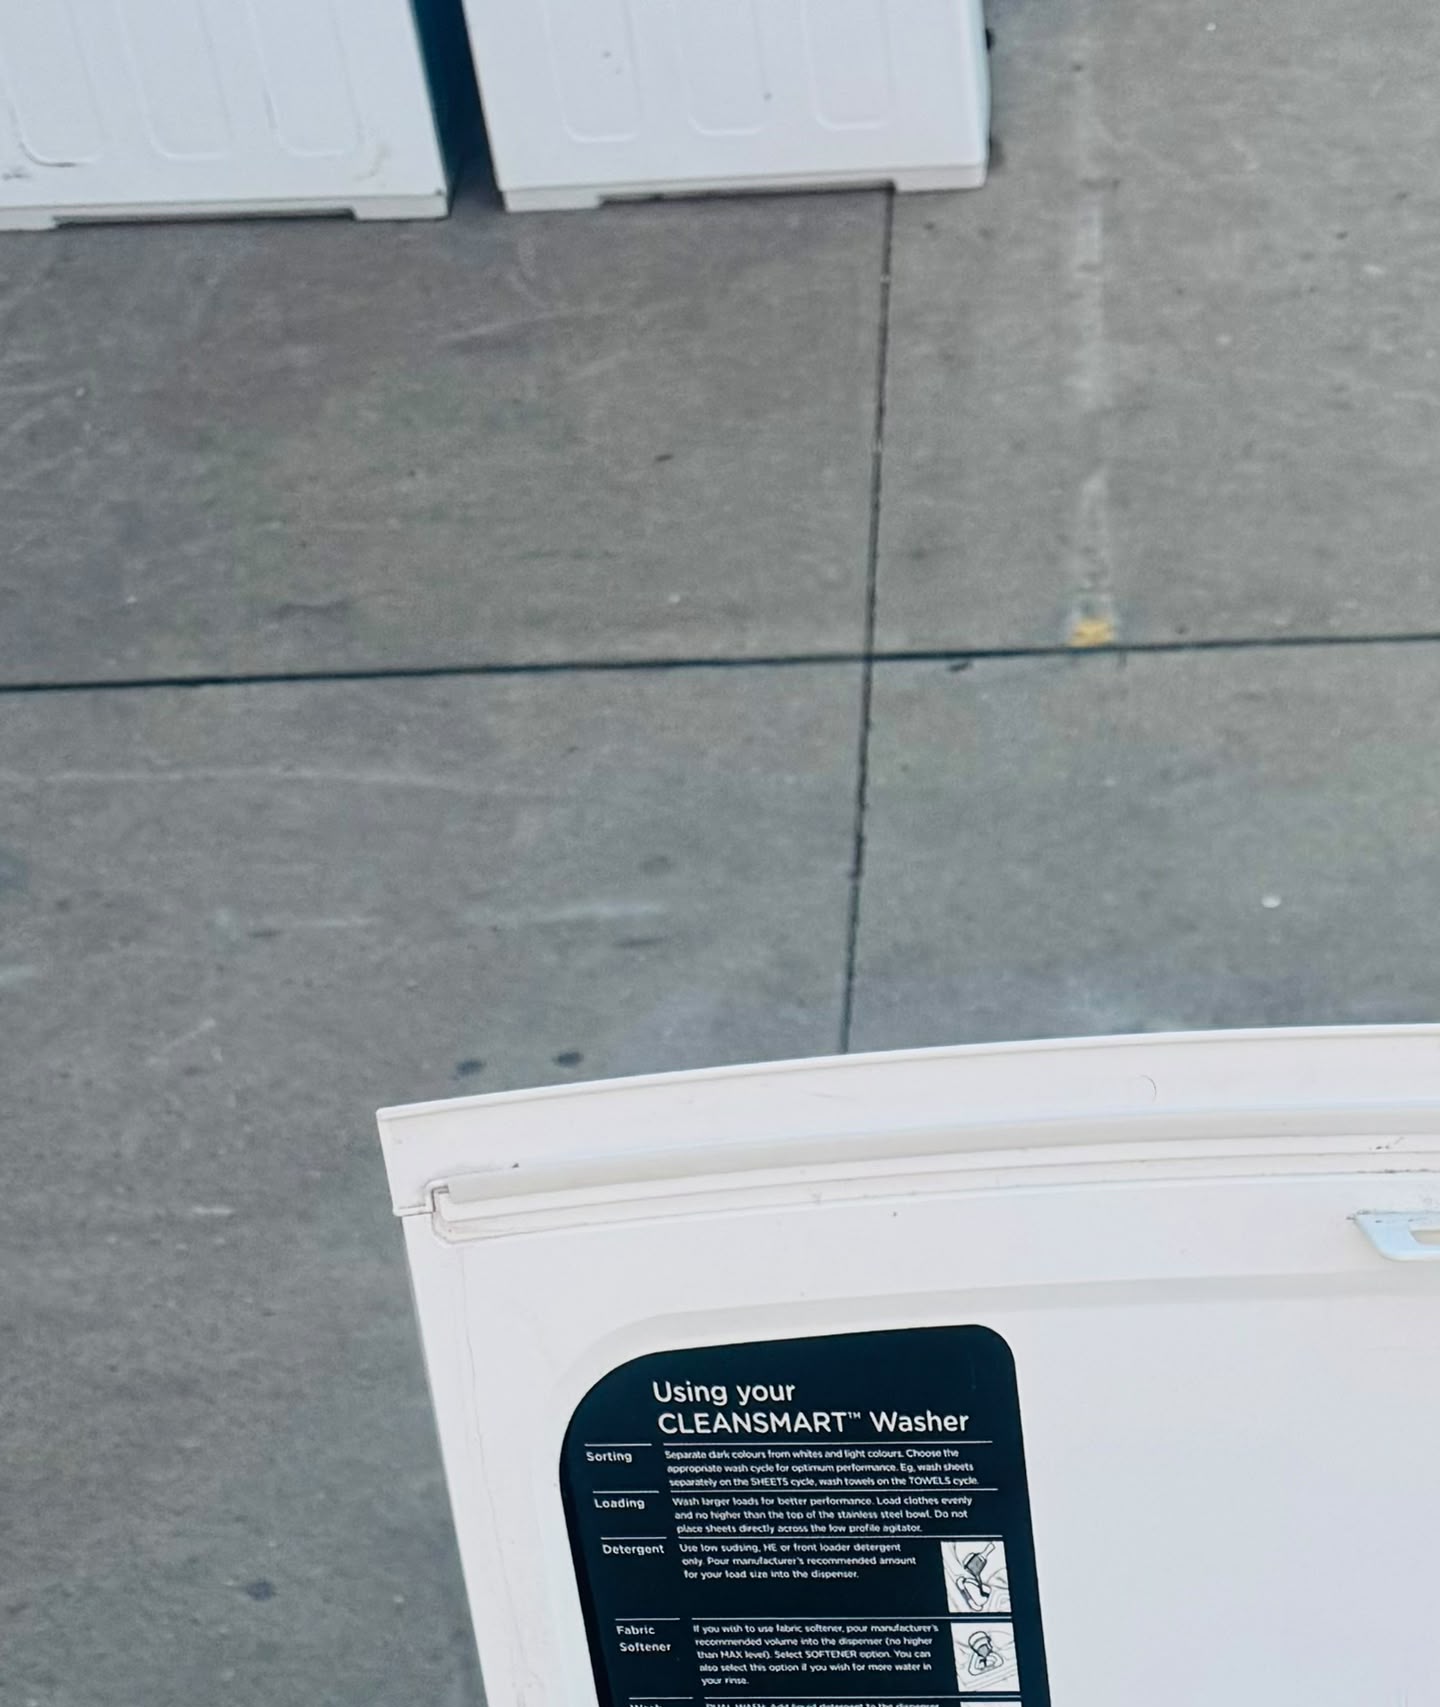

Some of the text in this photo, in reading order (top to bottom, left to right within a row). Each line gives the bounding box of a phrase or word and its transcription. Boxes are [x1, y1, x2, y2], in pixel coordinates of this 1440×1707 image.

[652, 1380, 796, 1406] Using your
[658, 1410, 970, 1434] CLEANSMART™ Washer
[585, 1451, 633, 1463] Sorting
[593, 1498, 645, 1510] Loading
[671, 1497, 700, 1507] Wash
[701, 1497, 730, 1507] larger
[732, 1496, 760, 1506] loads
[760, 1496, 775, 1506] for
[776, 1496, 808, 1506] better
[875, 1496, 902, 1506] Load
[903, 1495, 940, 1505] clothes
[674, 1511, 694, 1520] and
[694, 1512, 709, 1520] no
[709, 1510, 741, 1521] higher
[743, 1510, 767, 1519] than
[767, 1510, 785, 1520] the
[785, 1510, 804, 1520] top
[805, 1509, 816, 1519] of
[818, 1510, 835, 1519] the
[837, 1510, 878, 1519] stainless
[880, 1509, 904, 1519] steel
[934, 1509, 949, 1519] Do
[676, 1523, 923, 1535] place sheets directly across the low profile agitator.
[602, 1544, 665, 1556] Detergent
[706, 1556, 917, 1566] Pour manufacturer's recommended amount
[683, 1569, 859, 1581] for your load size into the dispenser.
[615, 1625, 656, 1635] Fabric
[619, 1642, 671, 1652] Softener
